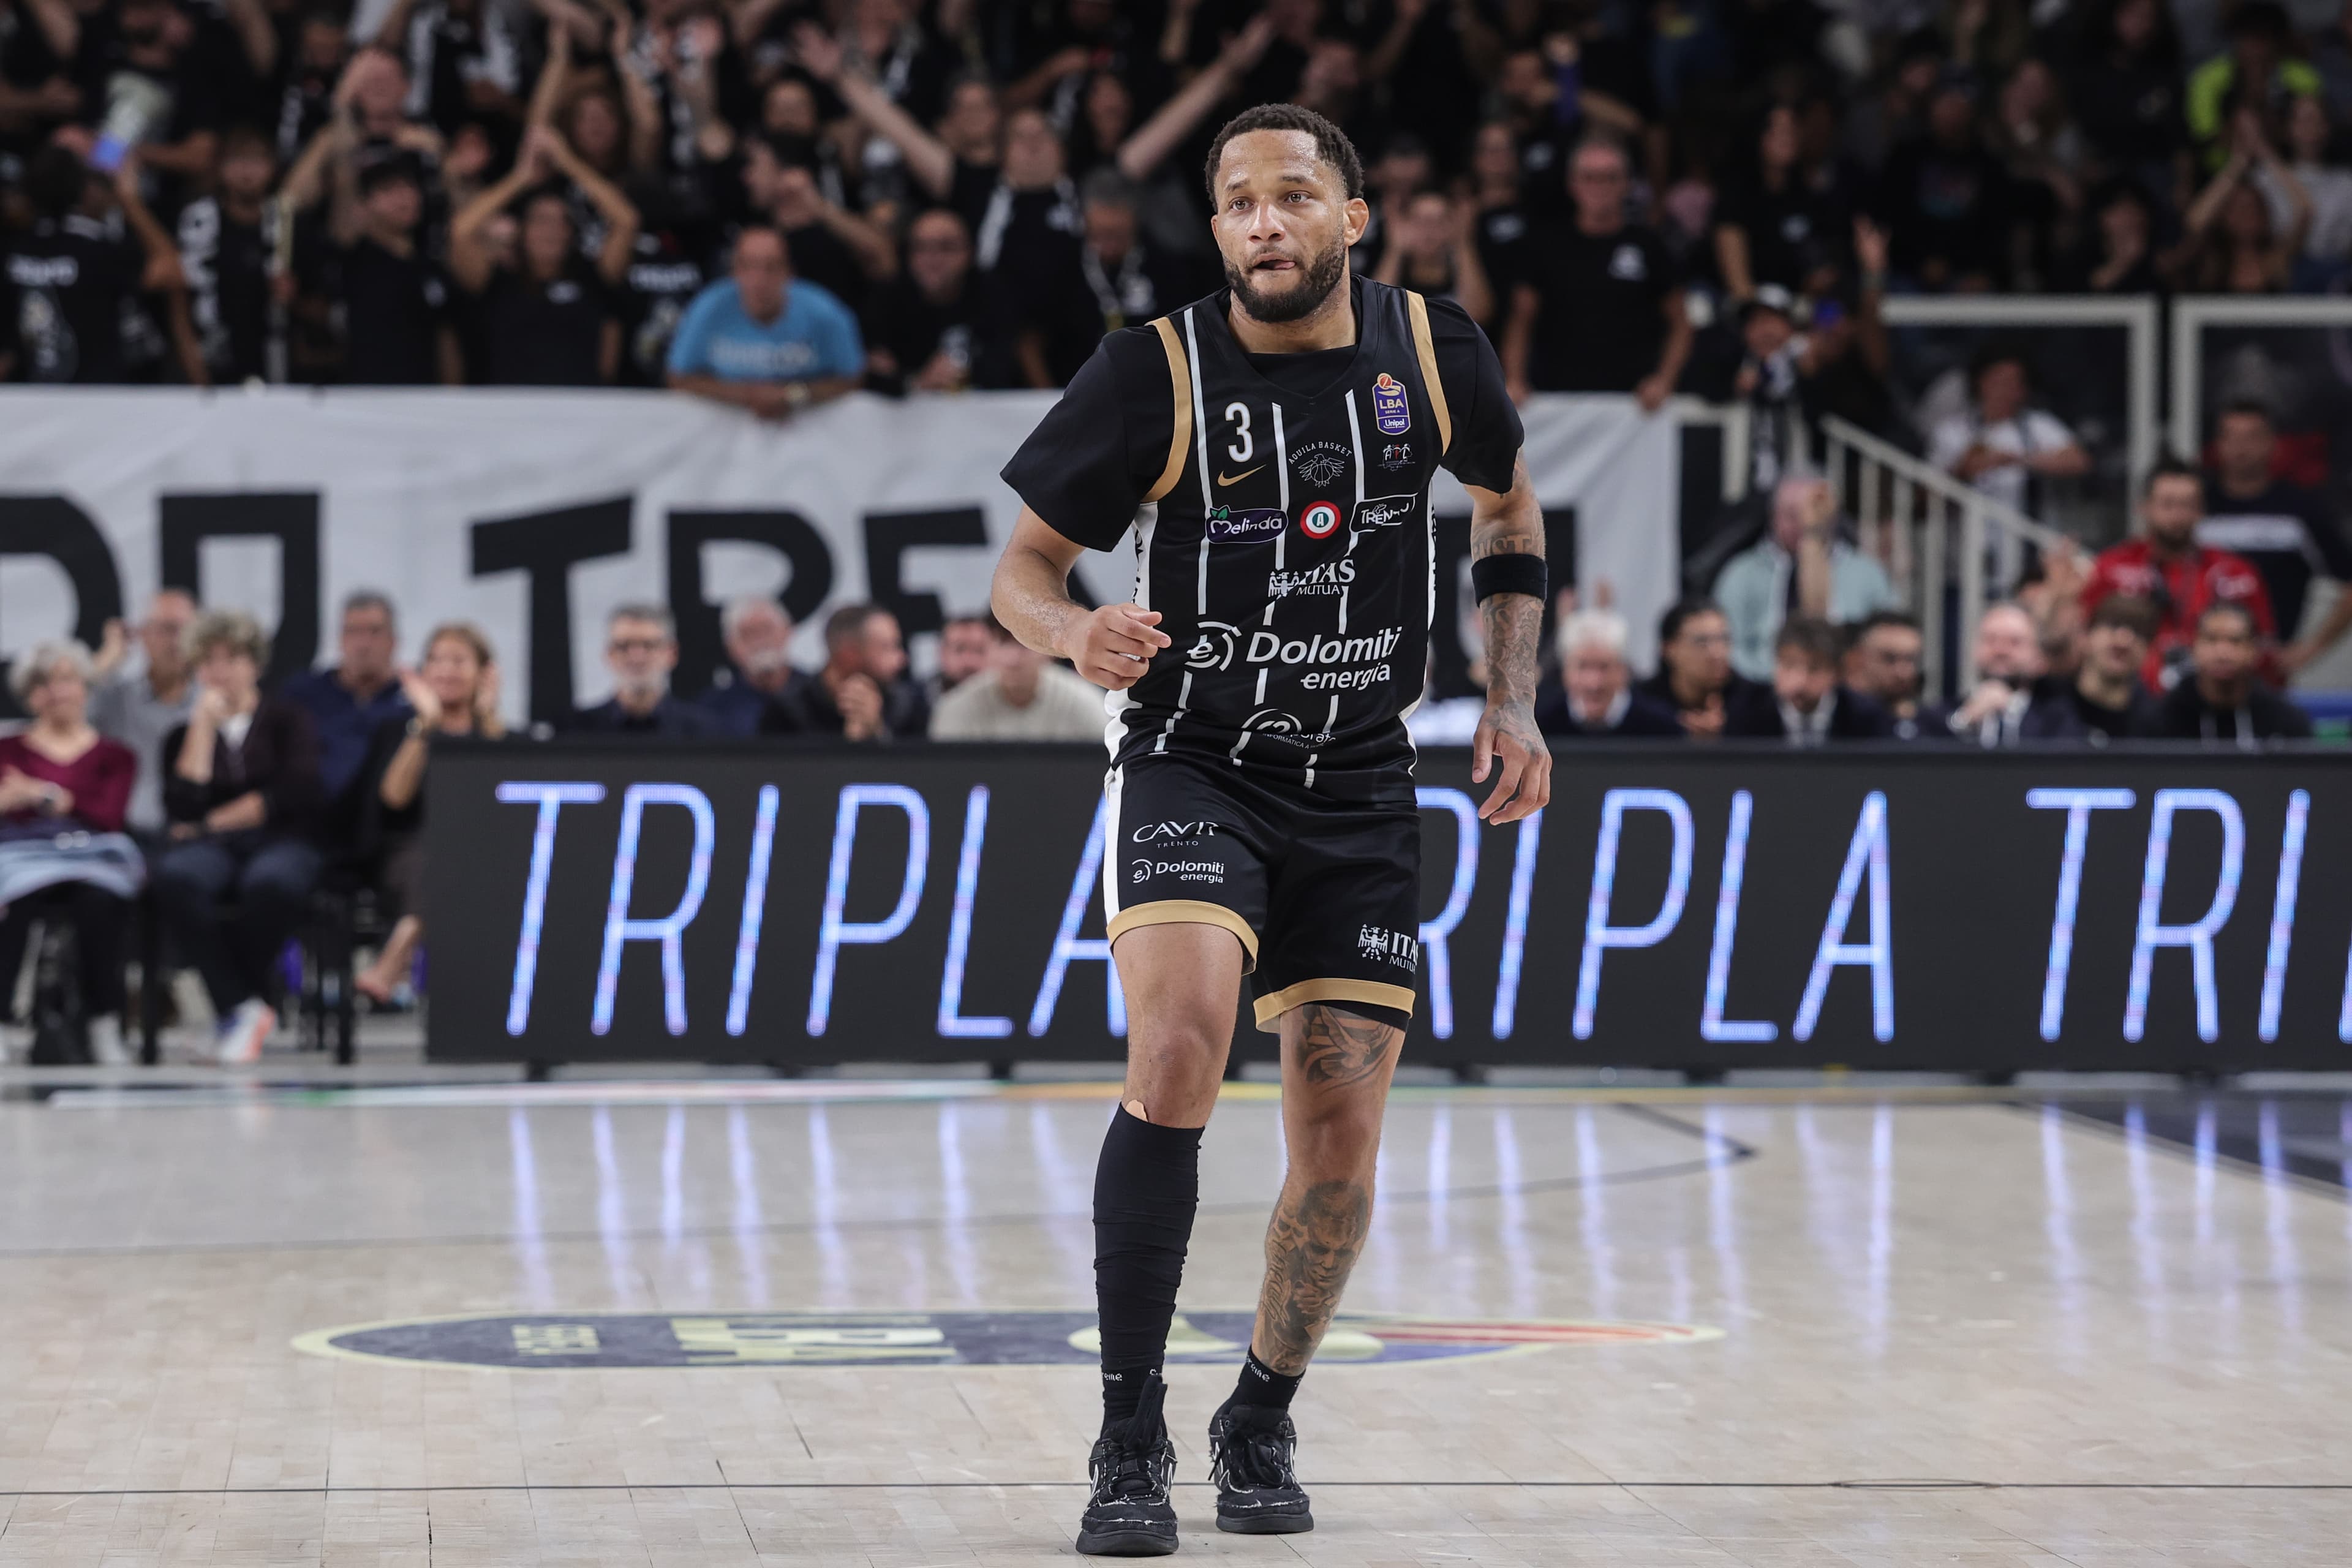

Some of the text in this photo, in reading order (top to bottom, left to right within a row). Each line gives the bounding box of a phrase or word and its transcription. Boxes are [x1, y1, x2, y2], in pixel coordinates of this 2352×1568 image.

[1379, 399, 1404, 409] LBA
[1225, 402, 1253, 462] 3
[1384, 418, 1405, 428] Unipol
[1288, 441, 1352, 465] AQUILA BASKET
[1210, 516, 1283, 535] Melinda
[1298, 559, 1356, 586] ITAS
[1295, 584, 1341, 596] MUTUA
[1246, 626, 1403, 664] Dolomiti
[1300, 662, 1390, 691] energia
[1156, 840, 1199, 848] TRENTO
[1155, 860, 1225, 875] Dolomiti
[1178, 873, 1224, 884] energia
[495, 781, 2352, 1044] TRIPLA RIPLA TRI
